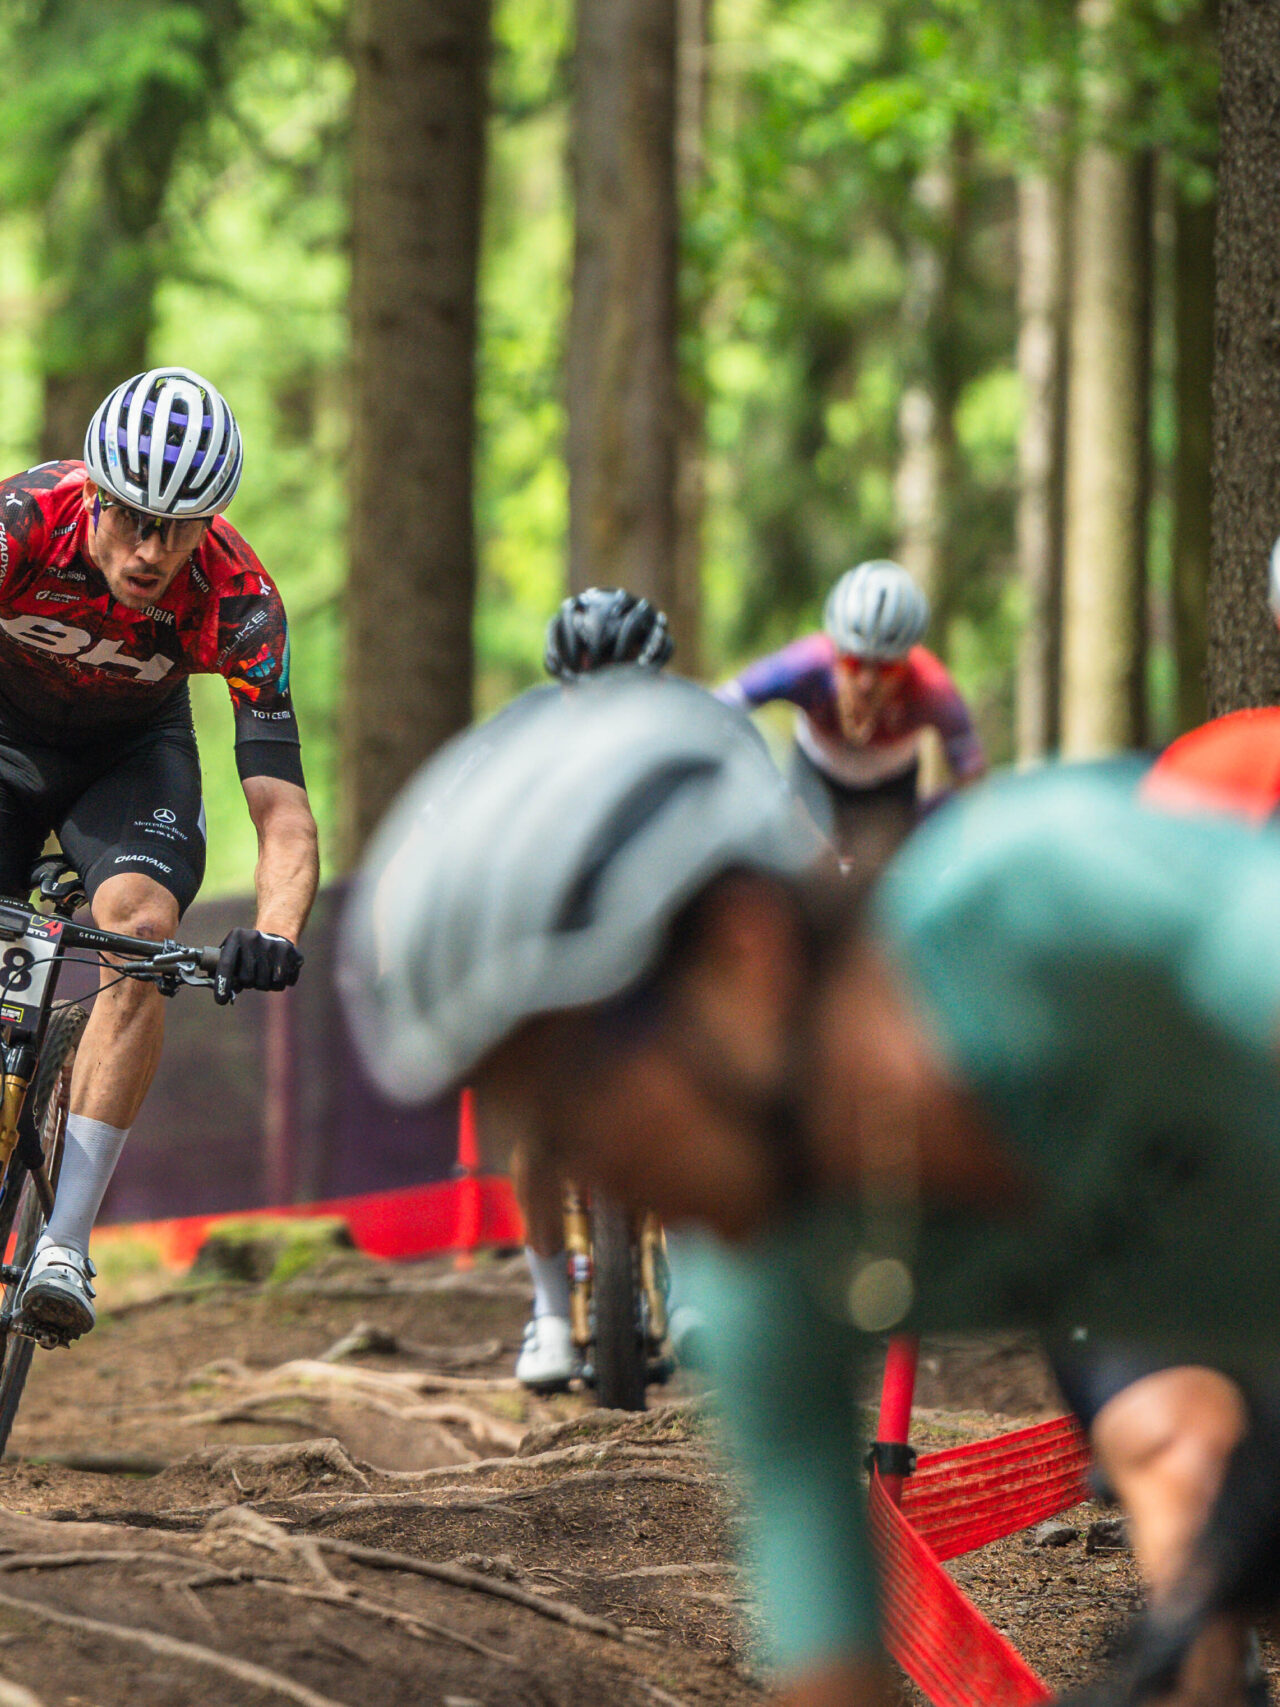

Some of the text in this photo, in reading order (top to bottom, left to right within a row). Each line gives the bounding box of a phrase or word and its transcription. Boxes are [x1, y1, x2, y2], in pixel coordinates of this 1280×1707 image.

[141, 604, 176, 626] OBIK
[114, 854, 173, 874] CHAOYANG
[78, 931, 109, 943] GEMINI
